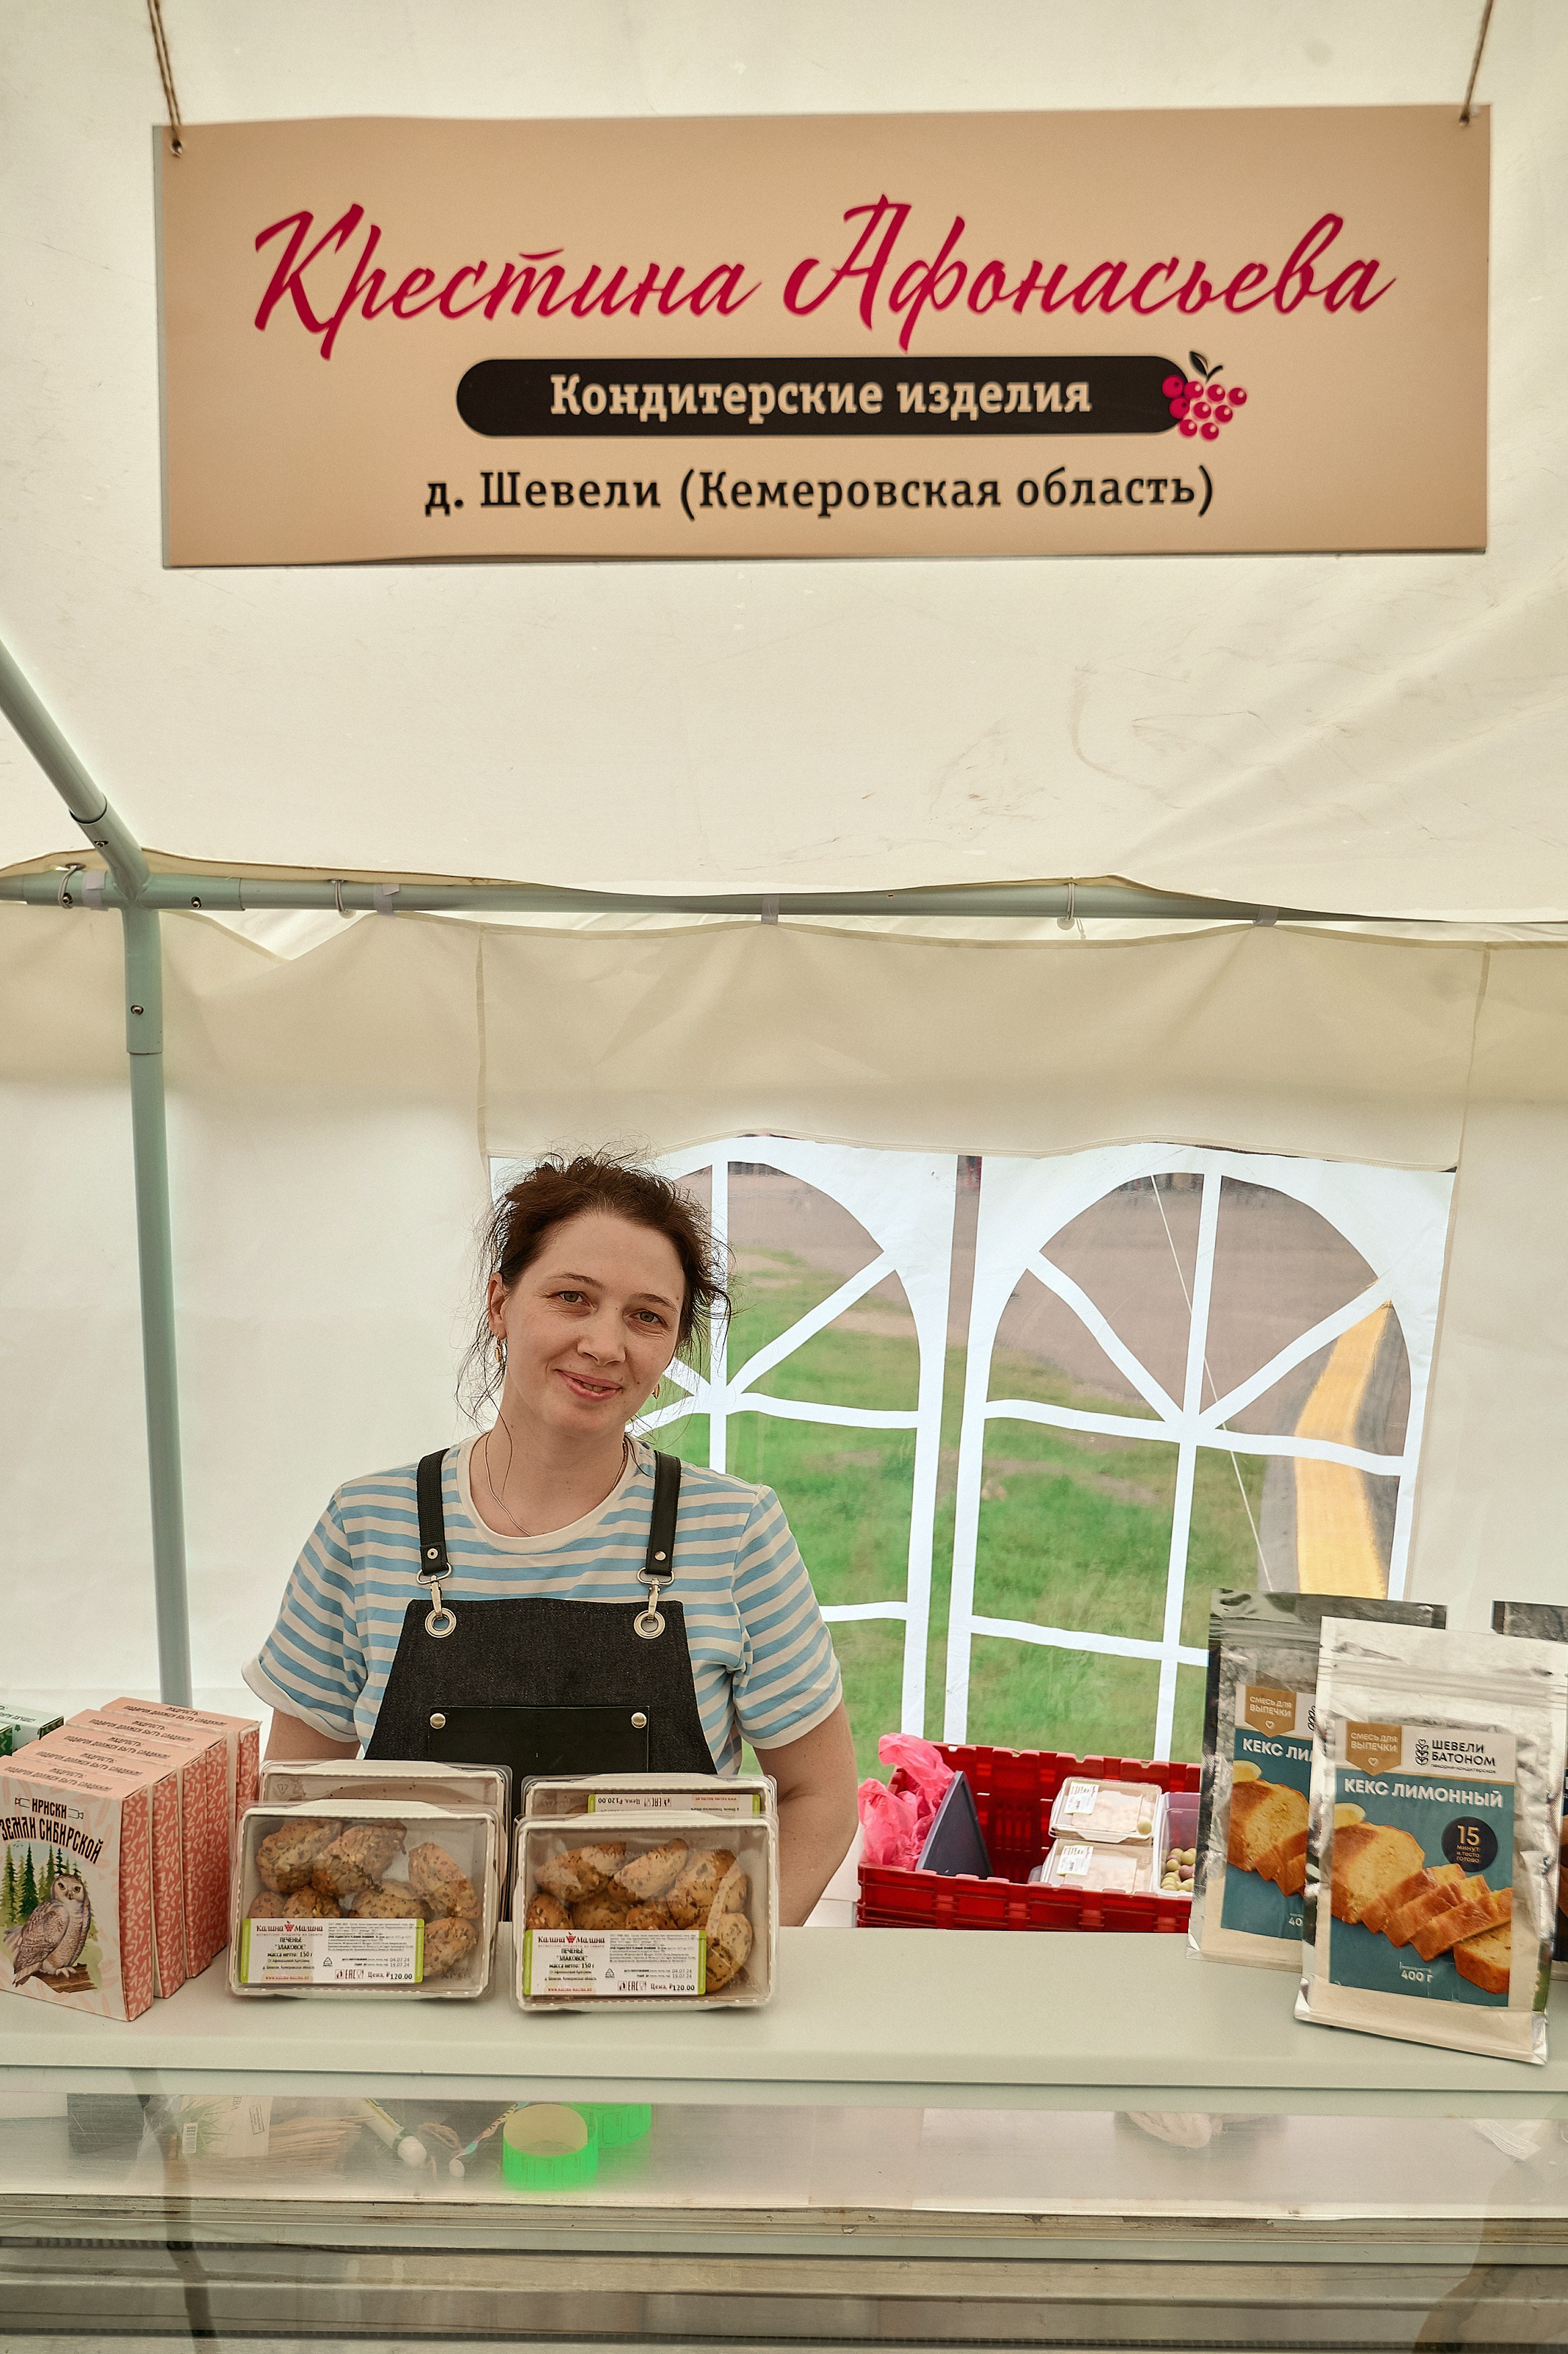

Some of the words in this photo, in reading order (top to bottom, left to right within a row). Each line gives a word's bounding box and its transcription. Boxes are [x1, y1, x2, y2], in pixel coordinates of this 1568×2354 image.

[254, 204, 763, 360] Крестина
[782, 194, 1398, 354] Афонасьева
[550, 374, 884, 424] Кондитерские
[896, 381, 1093, 422] изделия
[425, 483, 464, 517] д.
[480, 471, 661, 507] Шевели
[680, 469, 1002, 520] (Кемеровская
[1017, 465, 1213, 516] область)
[1249, 1696, 1276, 1705] СМЕСЬ
[1276, 1700, 1292, 1708] ДЛЯ
[1249, 1704, 1292, 1717] ВЫПЕЧКИ
[1350, 1732, 1379, 1742] СМЕСЬ
[1380, 1735, 1398, 1743] ДЛЯ
[1350, 1741, 1397, 1753] ВЫПЕЧКИ
[1432, 1739, 1484, 1753] ШЕВЕЛИ
[1243, 1737, 1284, 1757] КЕКС
[1285, 1745, 1312, 1762] ЛИ
[1432, 1751, 1496, 1766] БАТОНОМ
[1343, 1778, 1389, 1796] КЕКС
[1391, 1783, 1503, 1808] ЛИМОННЫЙ
[32, 1798, 67, 1819] ИРИСКИ
[39, 1818, 104, 1864] СИБИРСКОЙ
[1457, 1825, 1481, 1846] 15
[1401, 1969, 1424, 1982] 400
